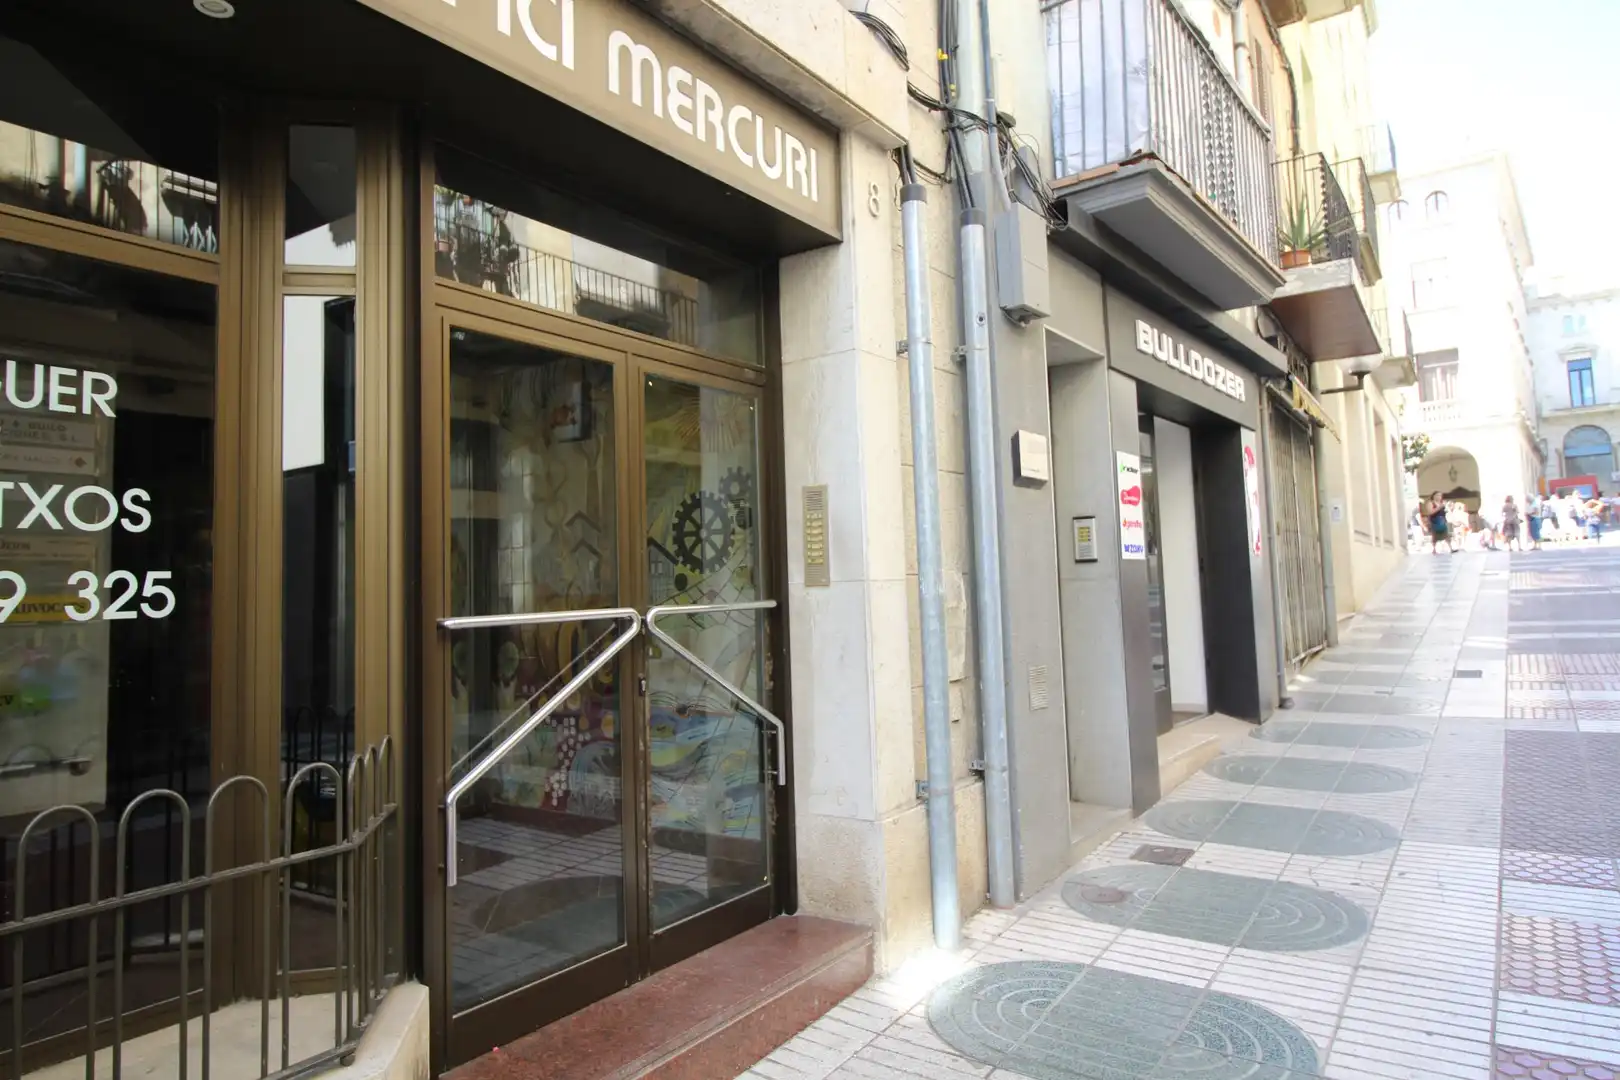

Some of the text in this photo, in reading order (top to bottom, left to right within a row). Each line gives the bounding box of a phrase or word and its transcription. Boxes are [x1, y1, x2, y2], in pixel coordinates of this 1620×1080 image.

[608, 30, 818, 202] MERCURI
[868, 181, 880, 218] 8
[0, 359, 118, 418] UER
[1135, 319, 1245, 402] BULLDOZER
[64, 569, 176, 622] 325
